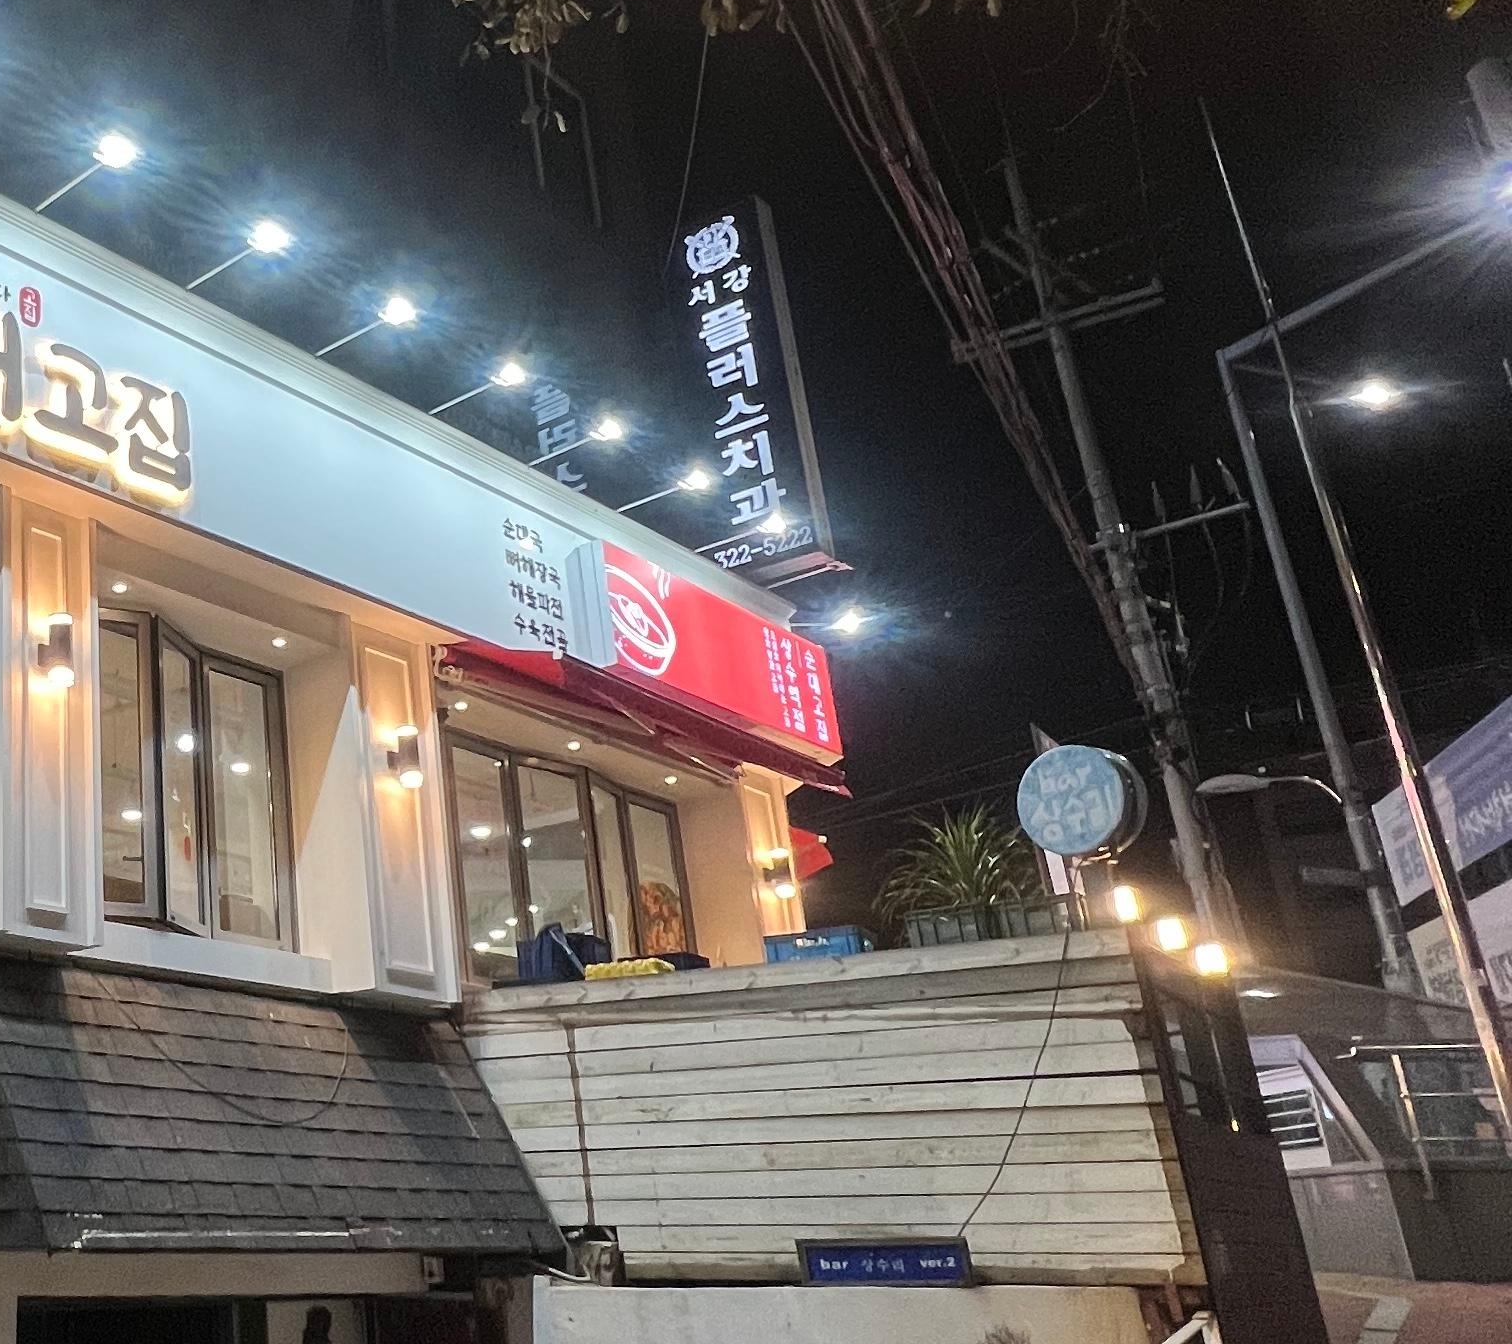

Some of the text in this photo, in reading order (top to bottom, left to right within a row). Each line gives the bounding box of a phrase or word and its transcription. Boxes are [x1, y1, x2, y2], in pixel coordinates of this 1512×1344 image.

[22, 288, 38, 324] 고집
[687, 264, 753, 307] 서강
[698, 297, 788, 528] 플러스치과
[502, 517, 543, 554] 순대국
[508, 579, 564, 621] 해물파전
[514, 612, 568, 654] 수육전골
[804, 649, 829, 742] 순대고집
[819, 1258, 849, 1270] bar
[919, 1256, 956, 1268] ver.2
